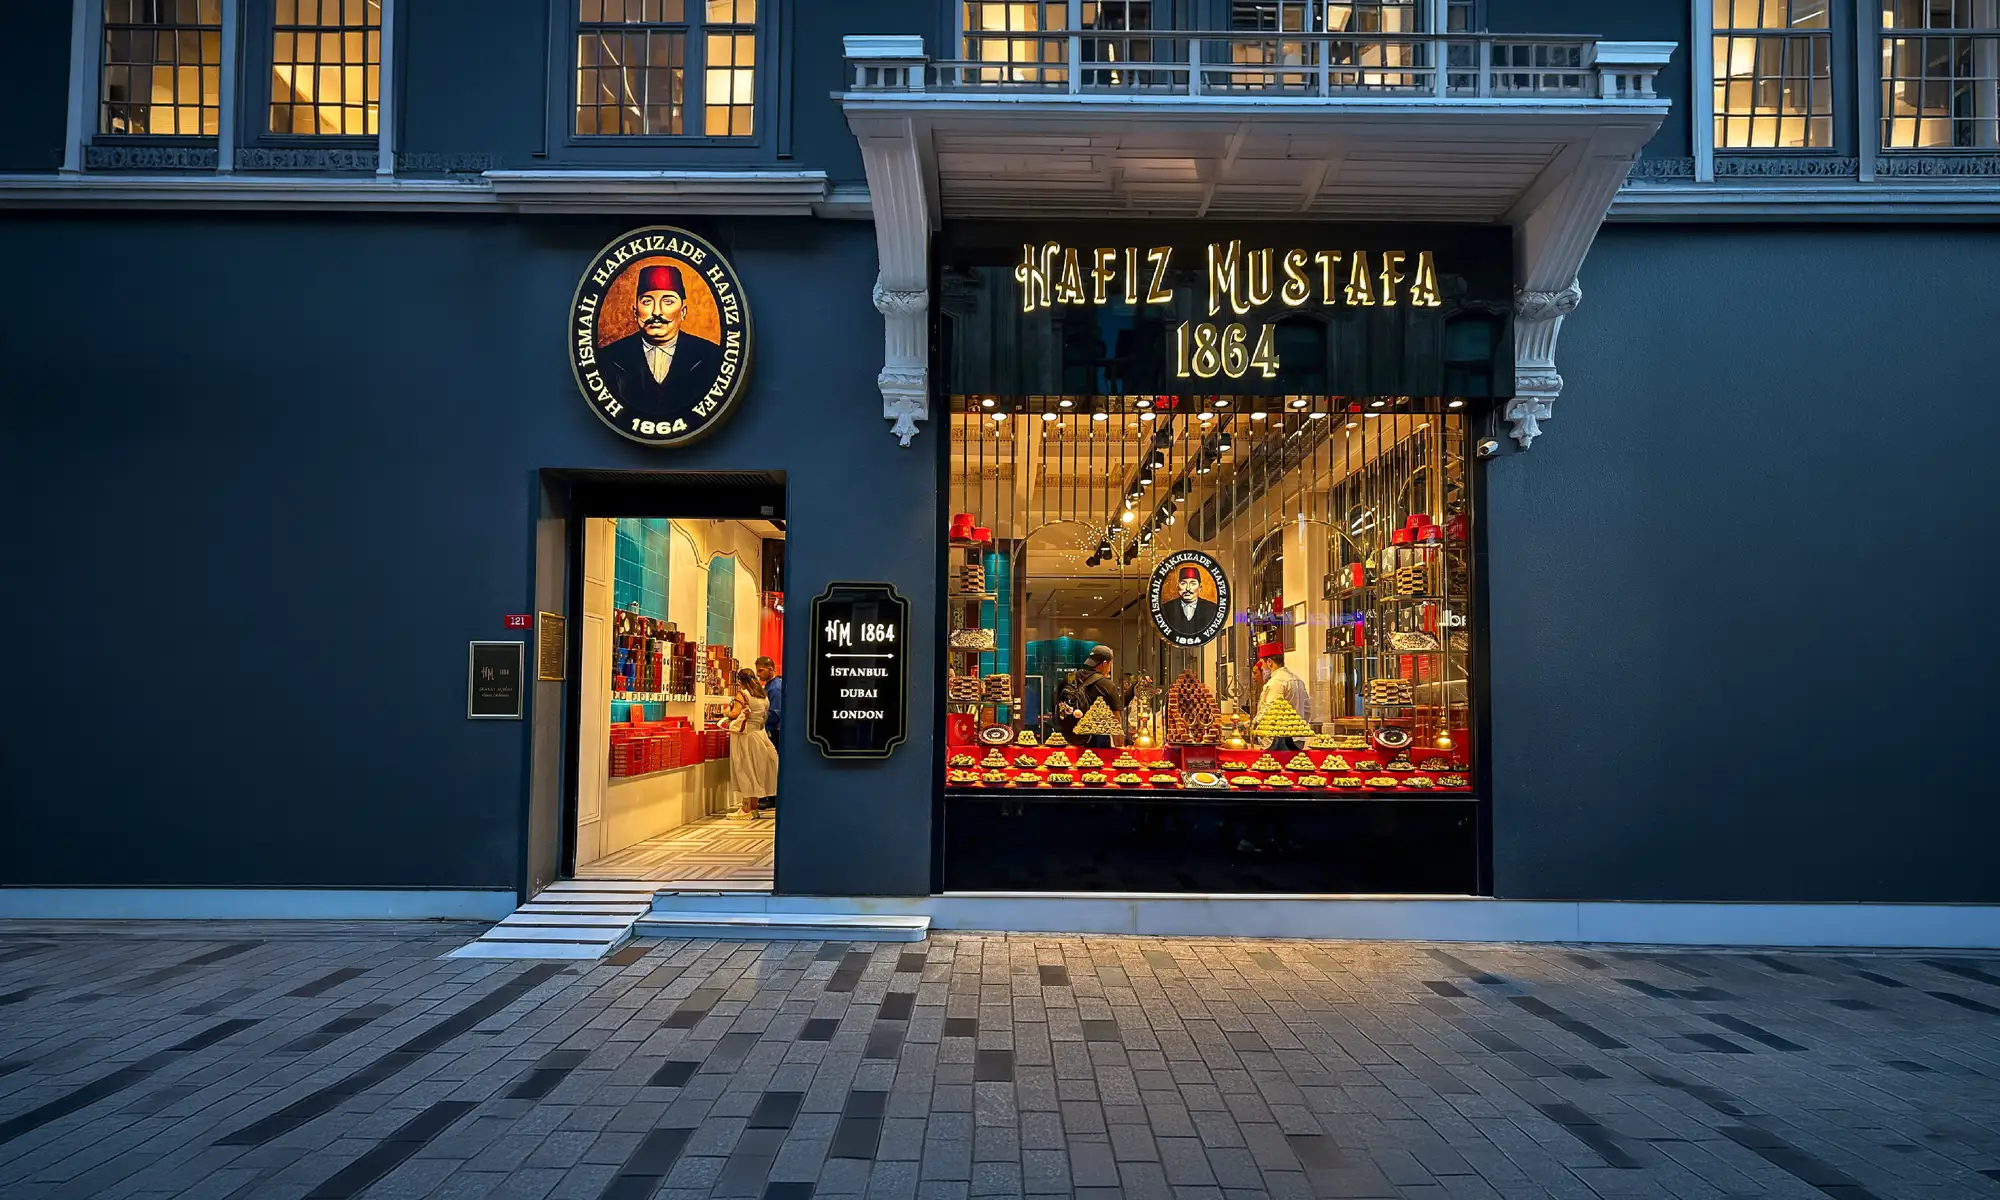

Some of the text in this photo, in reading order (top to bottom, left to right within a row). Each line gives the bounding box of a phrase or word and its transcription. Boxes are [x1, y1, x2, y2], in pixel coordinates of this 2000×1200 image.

[1014, 239, 1442, 316] HAFIZ MUSTAFA
[578, 235, 741, 418] HACI İSMAİL HAKKIZADE HAFIZ MUSTAFA
[1176, 320, 1280, 378] 1864
[631, 418, 688, 435] 1864
[1159, 553, 1212, 577] HAKKIZADE
[1211, 567, 1227, 597] HAFIZ
[511, 616, 525, 626] 121
[1155, 613, 1172, 636] HACI
[1203, 597, 1227, 638] MUSTAFA
[825, 620, 895, 647] HM 1864
[830, 666, 889, 677] İSTANBUL
[840, 688, 878, 698] DUBAI
[832, 709, 885, 720] LONDON
